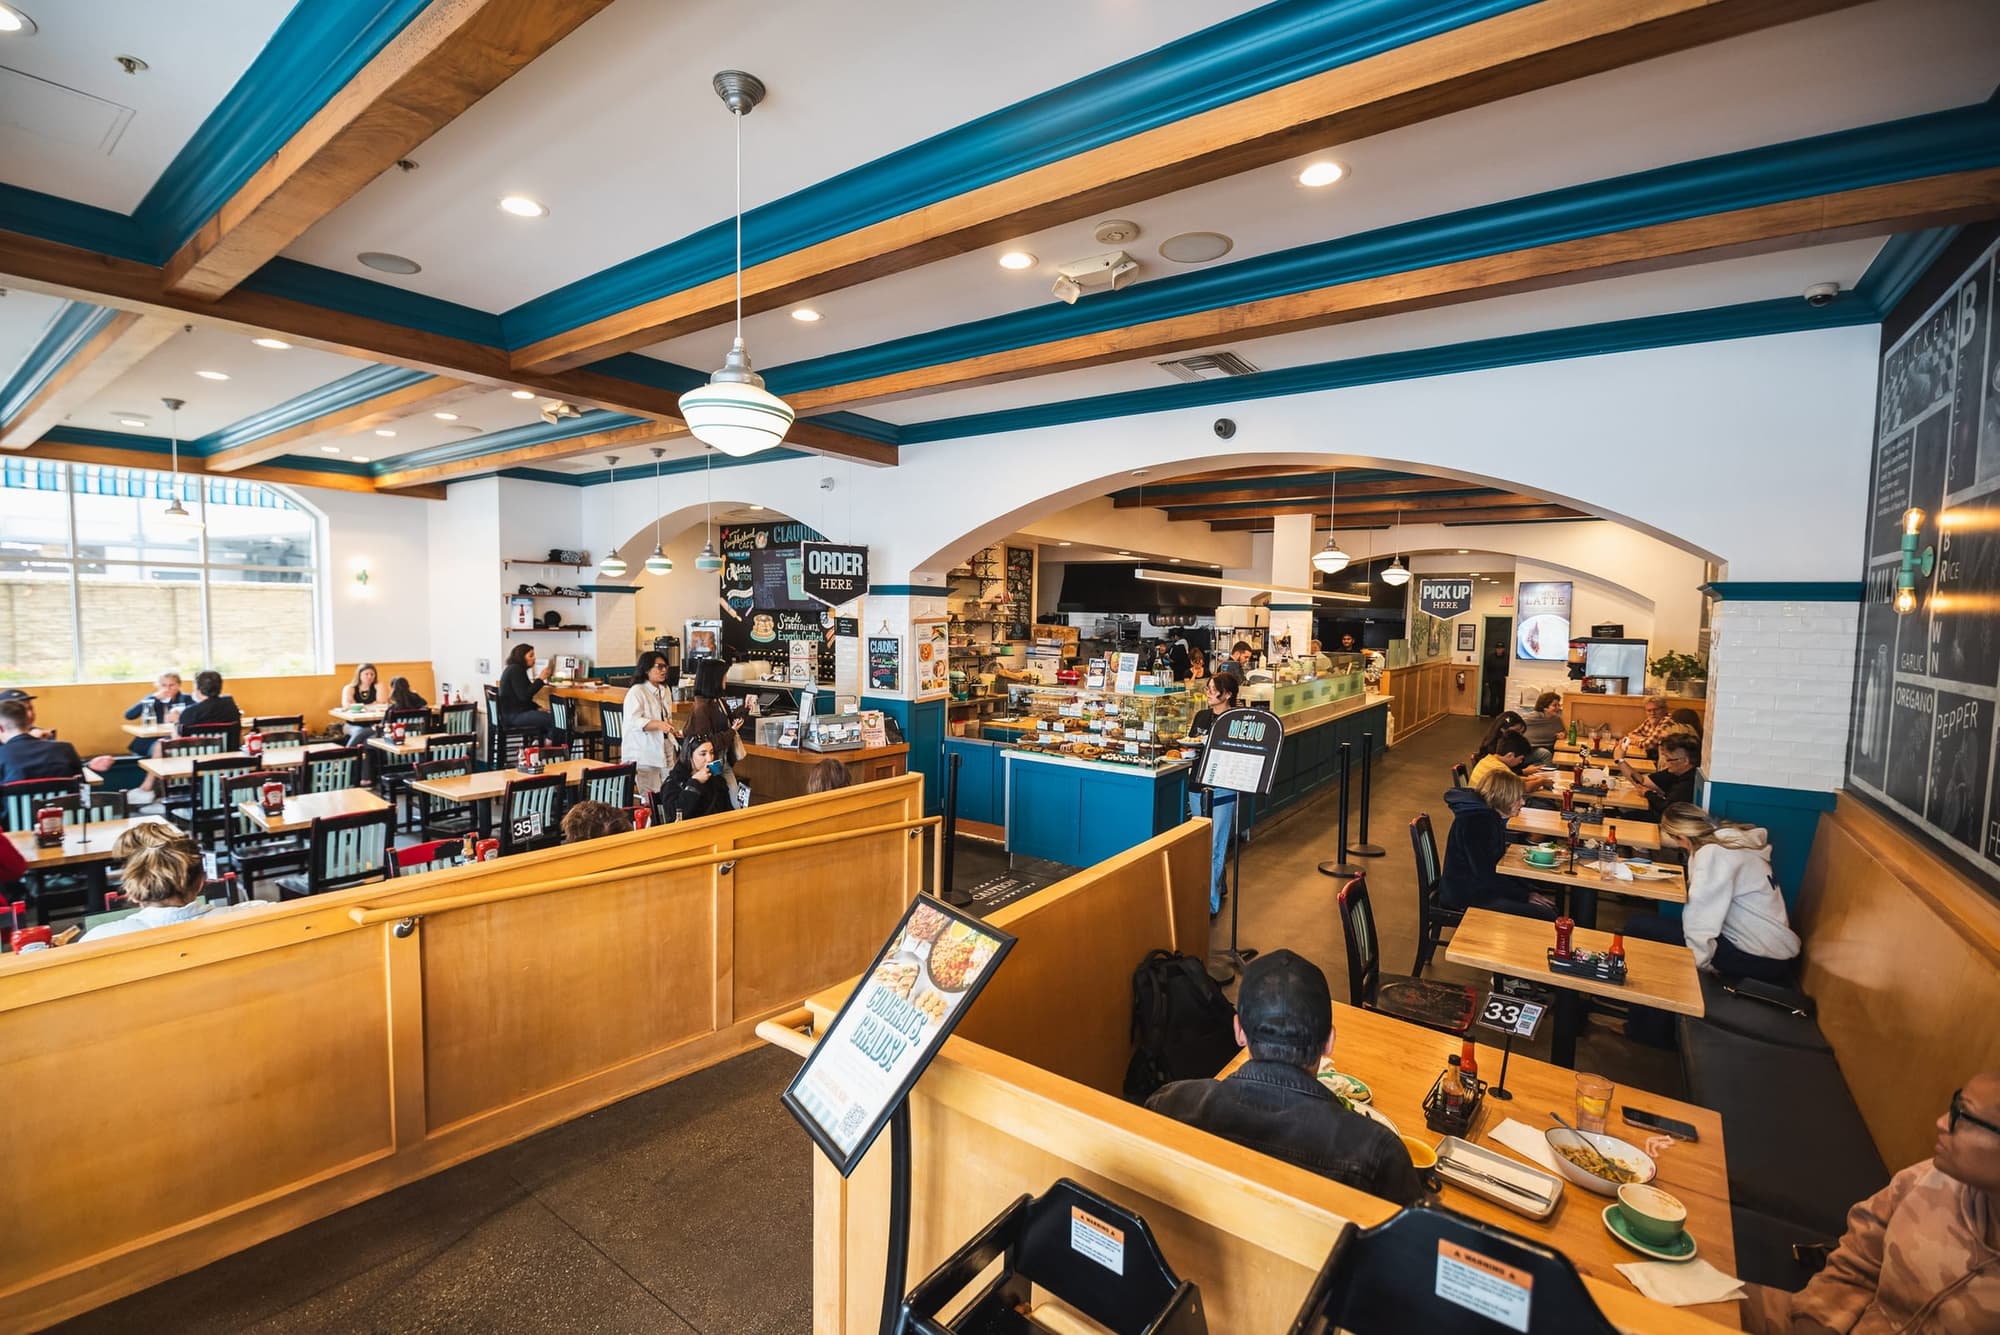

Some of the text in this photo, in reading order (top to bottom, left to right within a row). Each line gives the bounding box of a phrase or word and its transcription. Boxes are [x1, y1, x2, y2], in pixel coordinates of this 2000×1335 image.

[808, 550, 863, 576] ORDER
[820, 578, 853, 590] HERE
[1423, 585, 1470, 600] PICK UP
[1869, 566, 1901, 605] MILK
[1432, 601, 1458, 609] HERE
[1526, 596, 1566, 606] LATTE
[777, 612, 802, 629] Simple
[870, 640, 898, 653] CLAUDINE
[1901, 652, 1924, 672] GARLIC
[1895, 686, 1933, 714] OREGANO
[1937, 701, 1979, 738] PEPPER
[1228, 720, 1266, 742] MENU
[513, 820, 532, 836] 35
[866, 984, 929, 1047] CONGRATS,
[1484, 1002, 1520, 1024] 33
[850, 1013, 908, 1072] GRADS!
[1086, 1216, 1110, 1233] WARNING
[1464, 1254, 1506, 1275] WARNING
